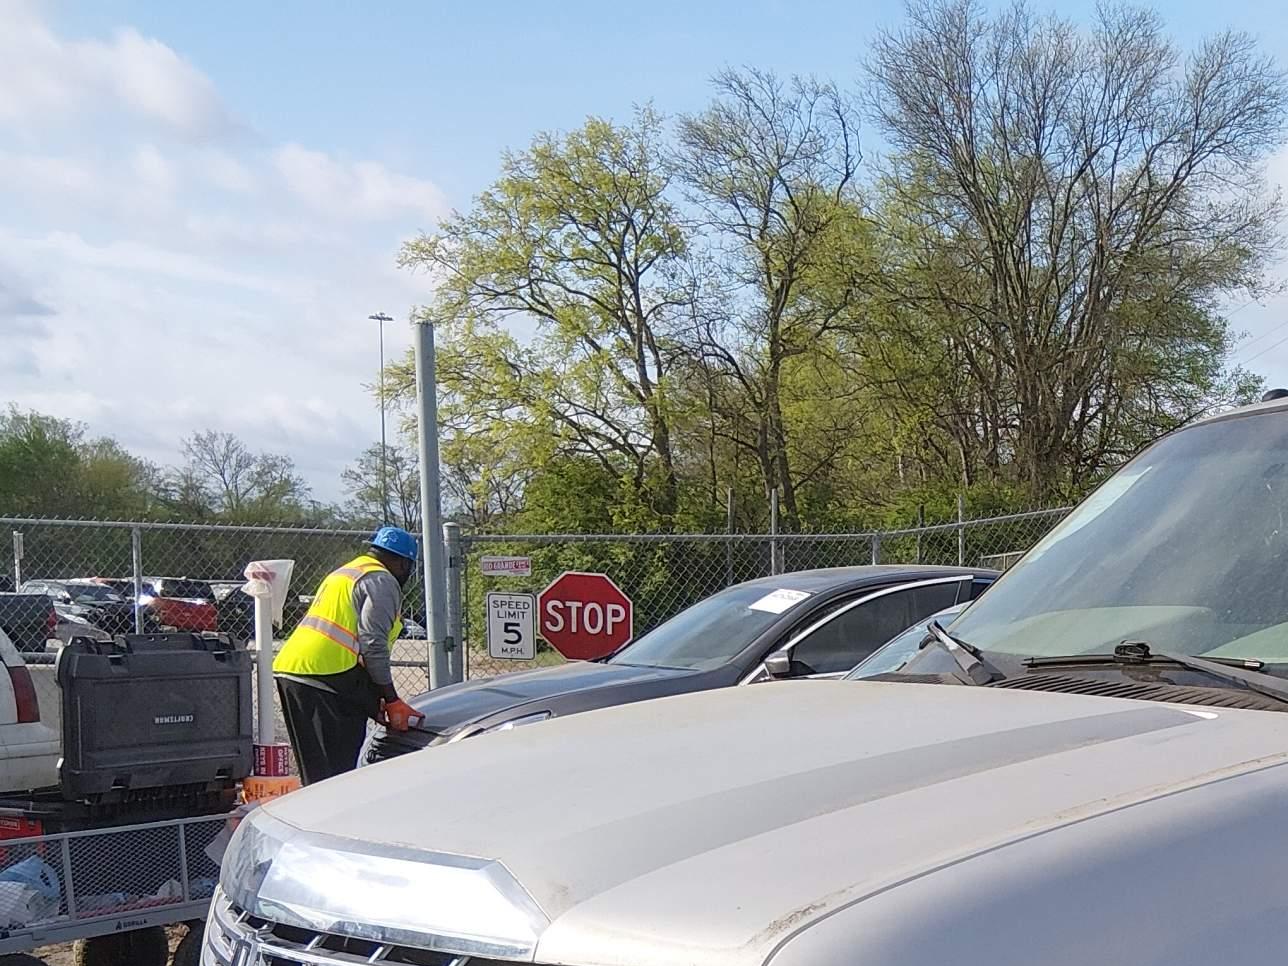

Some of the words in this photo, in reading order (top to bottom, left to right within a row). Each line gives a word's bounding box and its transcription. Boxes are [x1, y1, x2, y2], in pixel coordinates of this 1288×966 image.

[492, 600, 530, 610] SPEED
[497, 610, 527, 620] LIMIT
[545, 600, 626, 635] STOP
[503, 622, 523, 645] 5
[501, 647, 525, 655] M.P.H.
